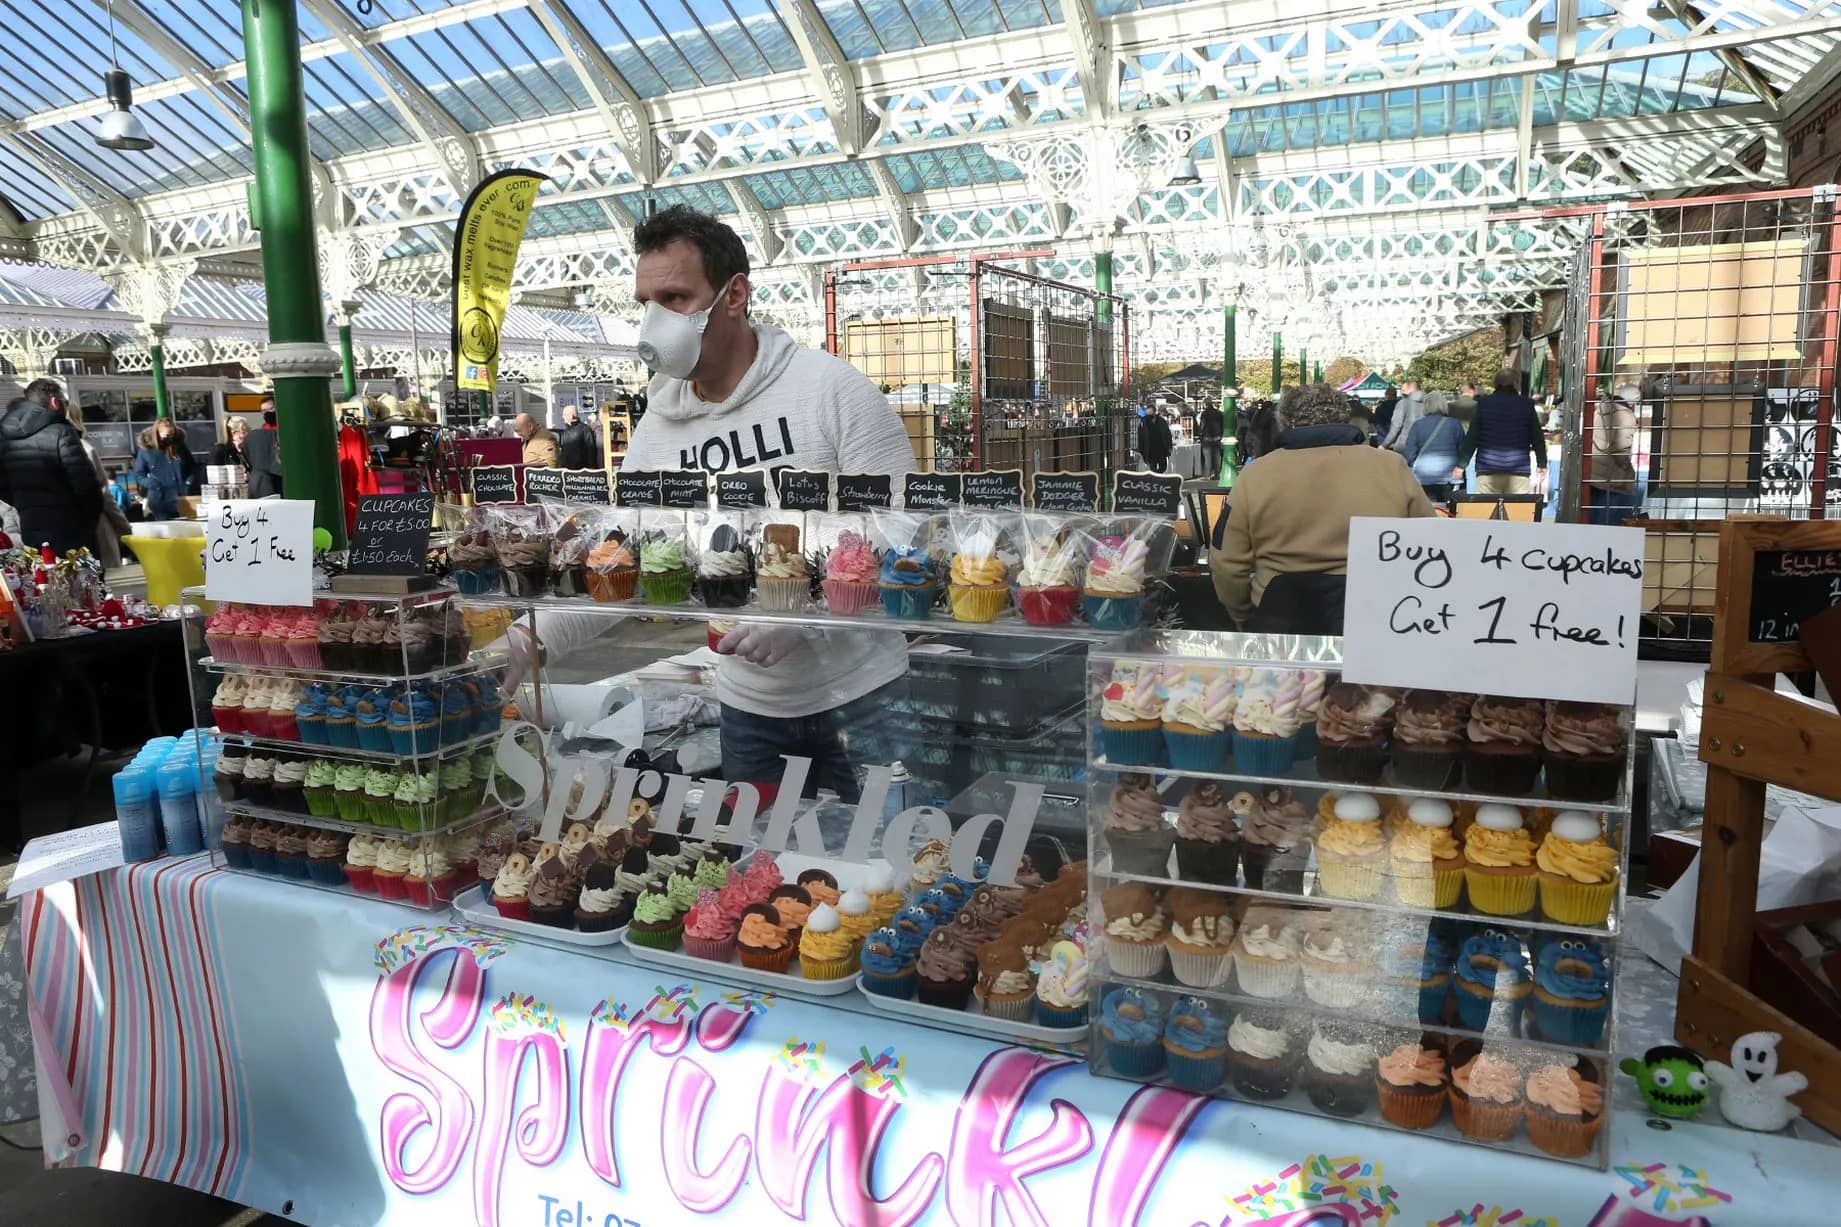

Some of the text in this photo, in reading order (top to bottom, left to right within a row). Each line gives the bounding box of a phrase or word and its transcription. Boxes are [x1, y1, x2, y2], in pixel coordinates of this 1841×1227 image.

[467, 214, 482, 245] melts
[464, 249, 475, 272] wax
[680, 416, 795, 474] HOLLI
[476, 473, 508, 481] CLASSIC
[619, 479, 661, 488] CHOCOLATE
[663, 478, 704, 488] CHOCOLATE
[789, 476, 820, 490] Lotus
[477, 483, 515, 492] CHOCOLATE
[529, 482, 560, 492] ROCHER
[721, 481, 748, 490] OREO
[908, 480, 947, 492] Cookie
[965, 486, 1019, 496] MERINGUE
[1038, 480, 1084, 491] JAMMIE
[1121, 480, 1173, 495] CLASSIC
[621, 490, 654, 499] ORANGE
[670, 488, 698, 498] MINT
[787, 491, 826, 505] Biscoff
[842, 485, 889, 506] Strawberry
[1041, 491, 1088, 501] DODGER
[361, 498, 432, 513] CUPCAKES
[1118, 495, 1167, 508] VANILLA
[221, 505, 269, 537] Buy 4
[358, 517, 431, 533] 4 FOR £5.00
[211, 536, 297, 567] Get 1 Free
[1378, 530, 1452, 588] Buy
[1480, 535, 1513, 570] 4
[1390, 595, 1456, 635] Get
[1474, 596, 1518, 644] 1
[1758, 619, 1779, 640] 12
[483, 721, 1048, 891] Sprinkled
